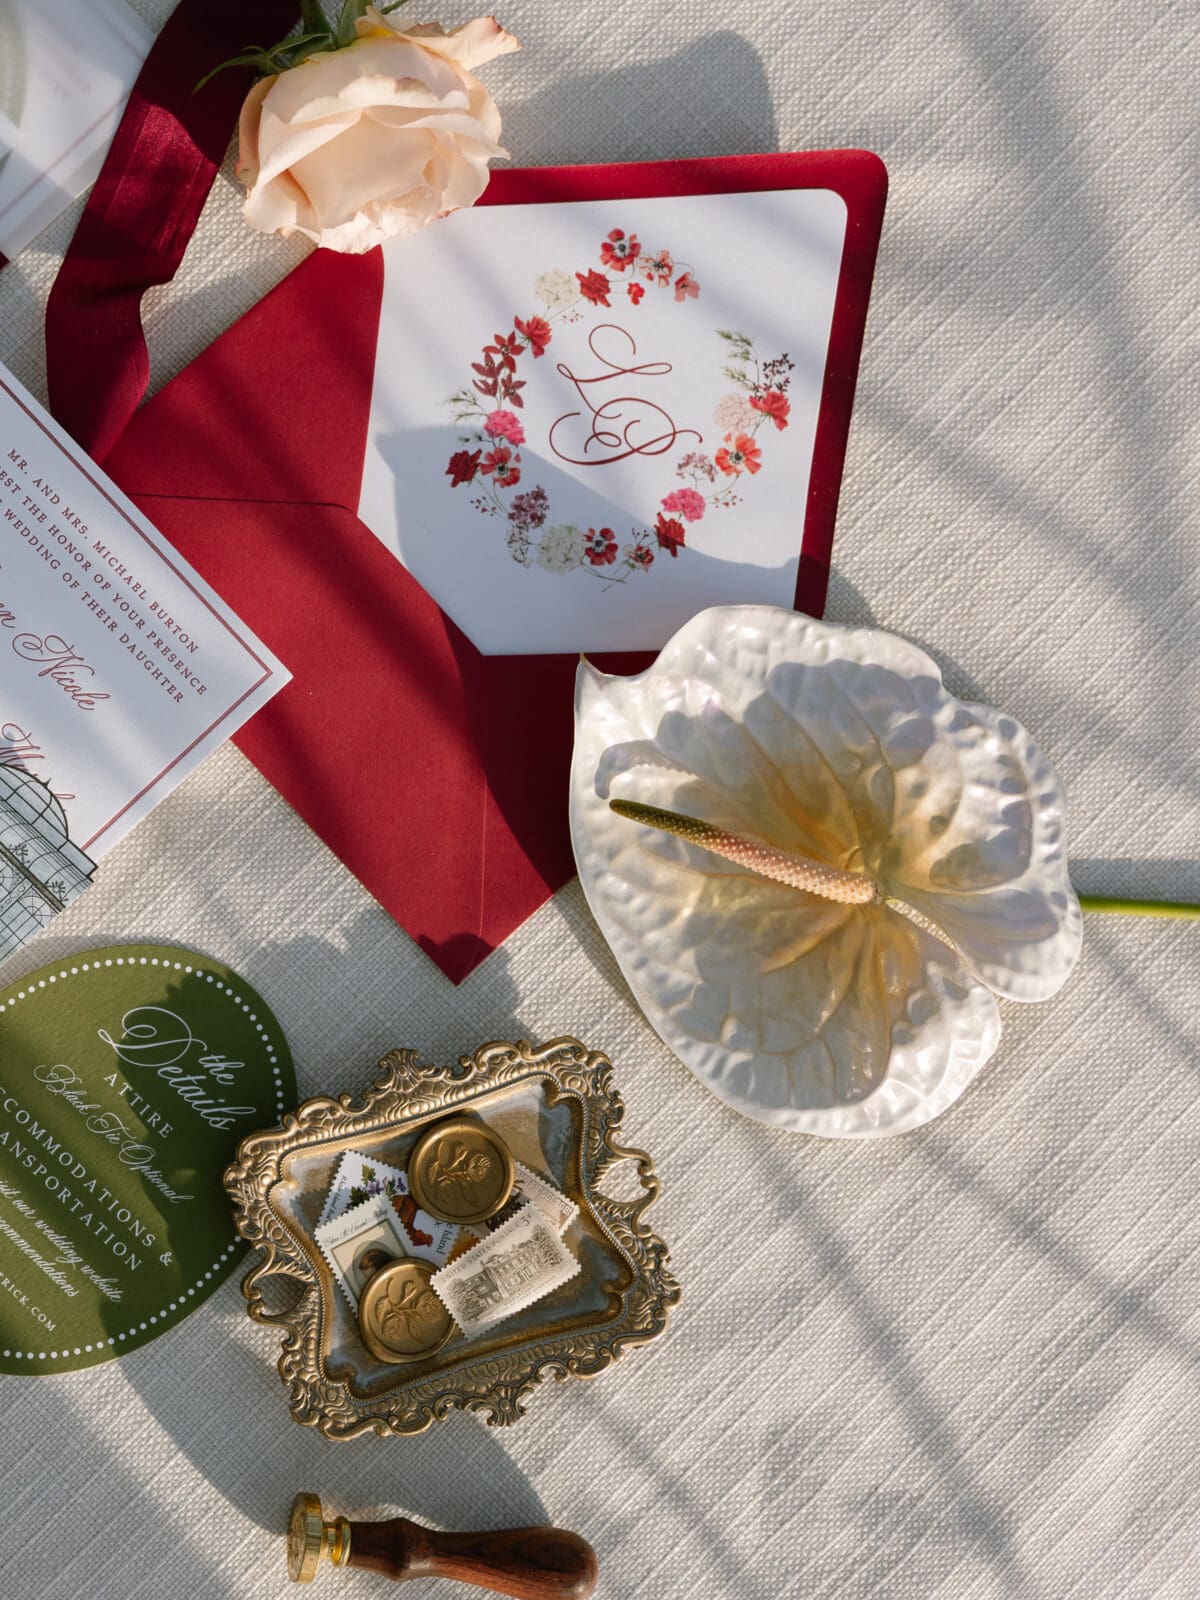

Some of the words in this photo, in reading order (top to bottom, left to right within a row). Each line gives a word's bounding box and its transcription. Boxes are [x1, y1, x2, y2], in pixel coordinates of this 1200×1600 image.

[8, 448, 28, 474] MR.
[32, 478, 60, 504] AND
[62, 506, 88, 540] MRS.
[92, 540, 148, 600] MICHAEL
[148, 600, 198, 654] BURTON
[22, 496, 48, 524] THE
[48, 524, 92, 572] HONOR
[94, 572, 112, 590] OF
[112, 592, 146, 630] YOUR
[146, 630, 208, 696] PRESENCE
[4, 508, 60, 570] WEDDING
[62, 572, 80, 588] OF
[80, 592, 118, 632] THEIR
[118, 632, 184, 704] DAUGHTER
[11, 631, 111, 711] Nicole
[98, 1006, 257, 1131] Details
[104, 1072, 174, 1138] ATTIRE
[198, 1053, 246, 1085] the
[33, 1063, 100, 1116] Black
[85, 1111, 136, 1145] Tie
[118, 1140, 194, 1204] Optional
[12, 1200, 36, 1218] our
[34, 1220, 84, 1270] wedding
[80, 1264, 124, 1302] website
[160, 1252, 172, 1266] &
[441, 1263, 467, 1281] UNITED
[467, 1245, 491, 1266] STATES
[490, 1221, 521, 1246] POSTAGE
